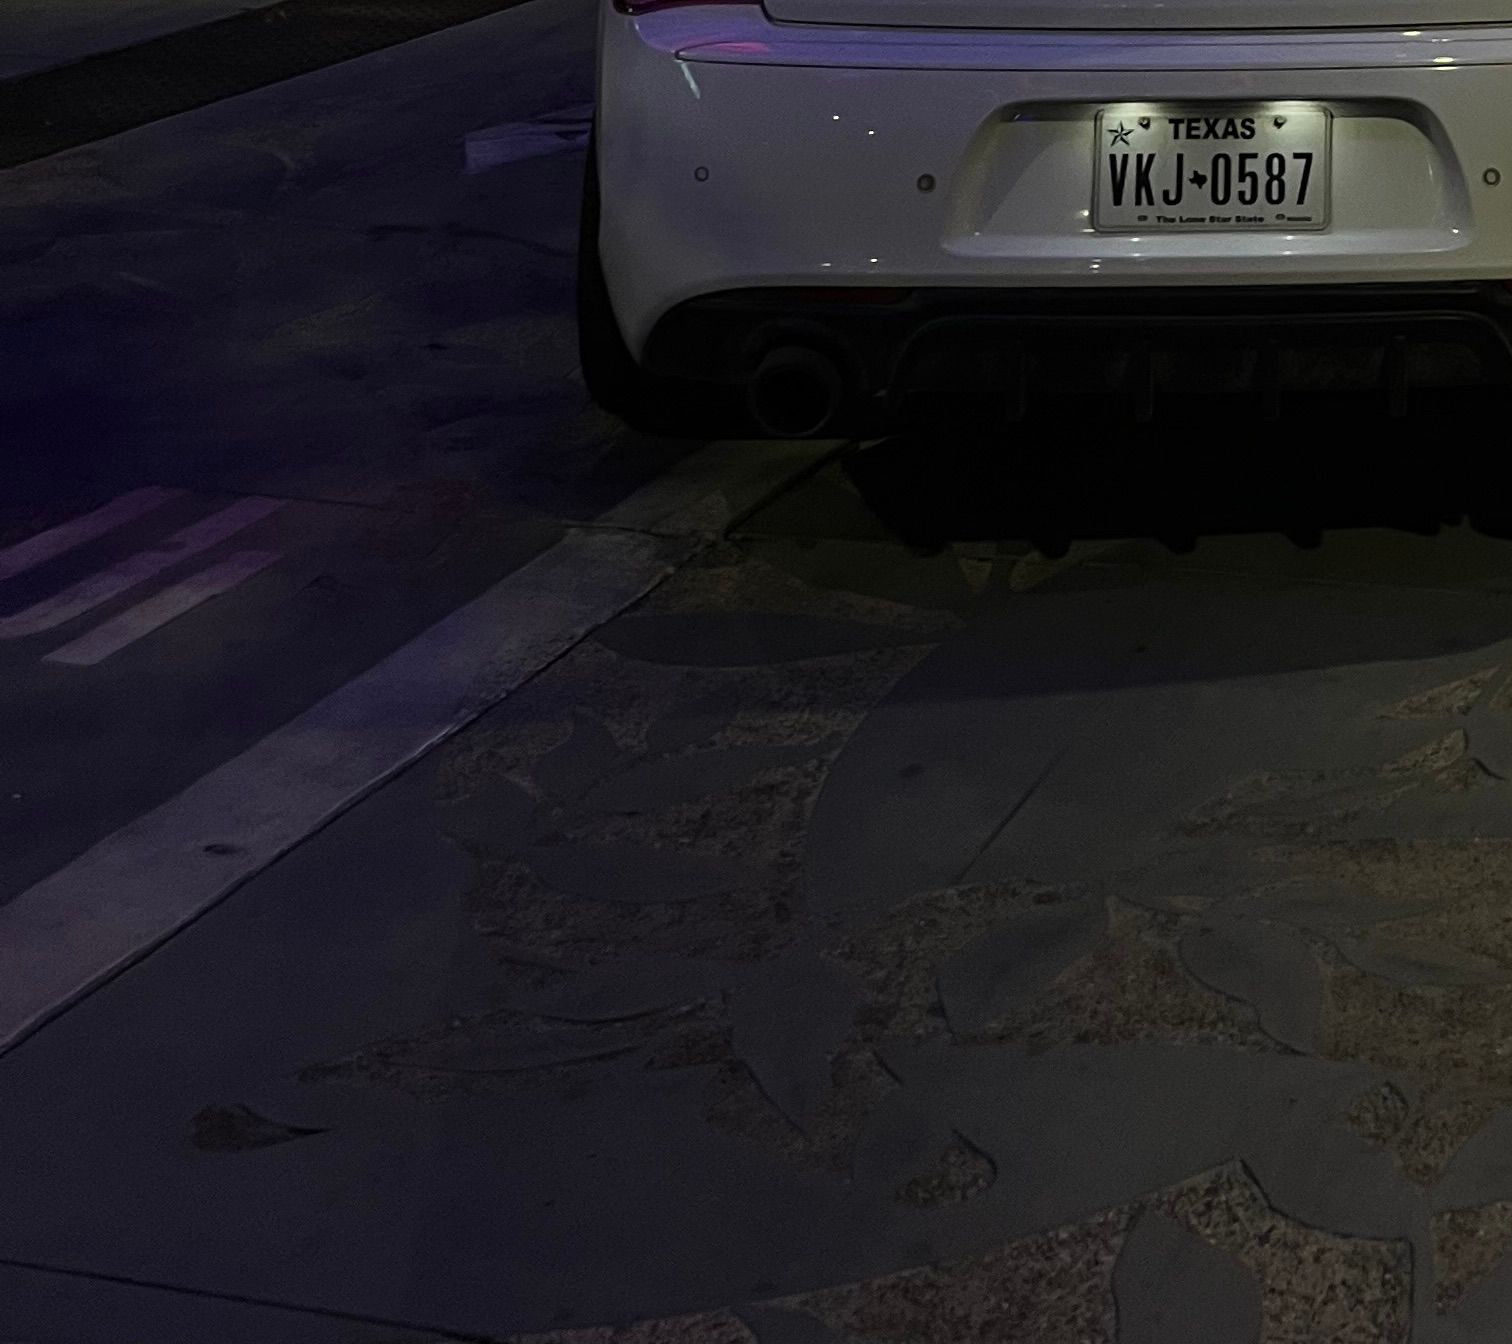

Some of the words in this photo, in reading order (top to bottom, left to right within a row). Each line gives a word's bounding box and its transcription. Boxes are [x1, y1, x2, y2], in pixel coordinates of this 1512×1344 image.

[1169, 118, 1256, 140] TEXAS
[1109, 153, 1185, 206] VKJ
[1211, 152, 1313, 205] 0587
